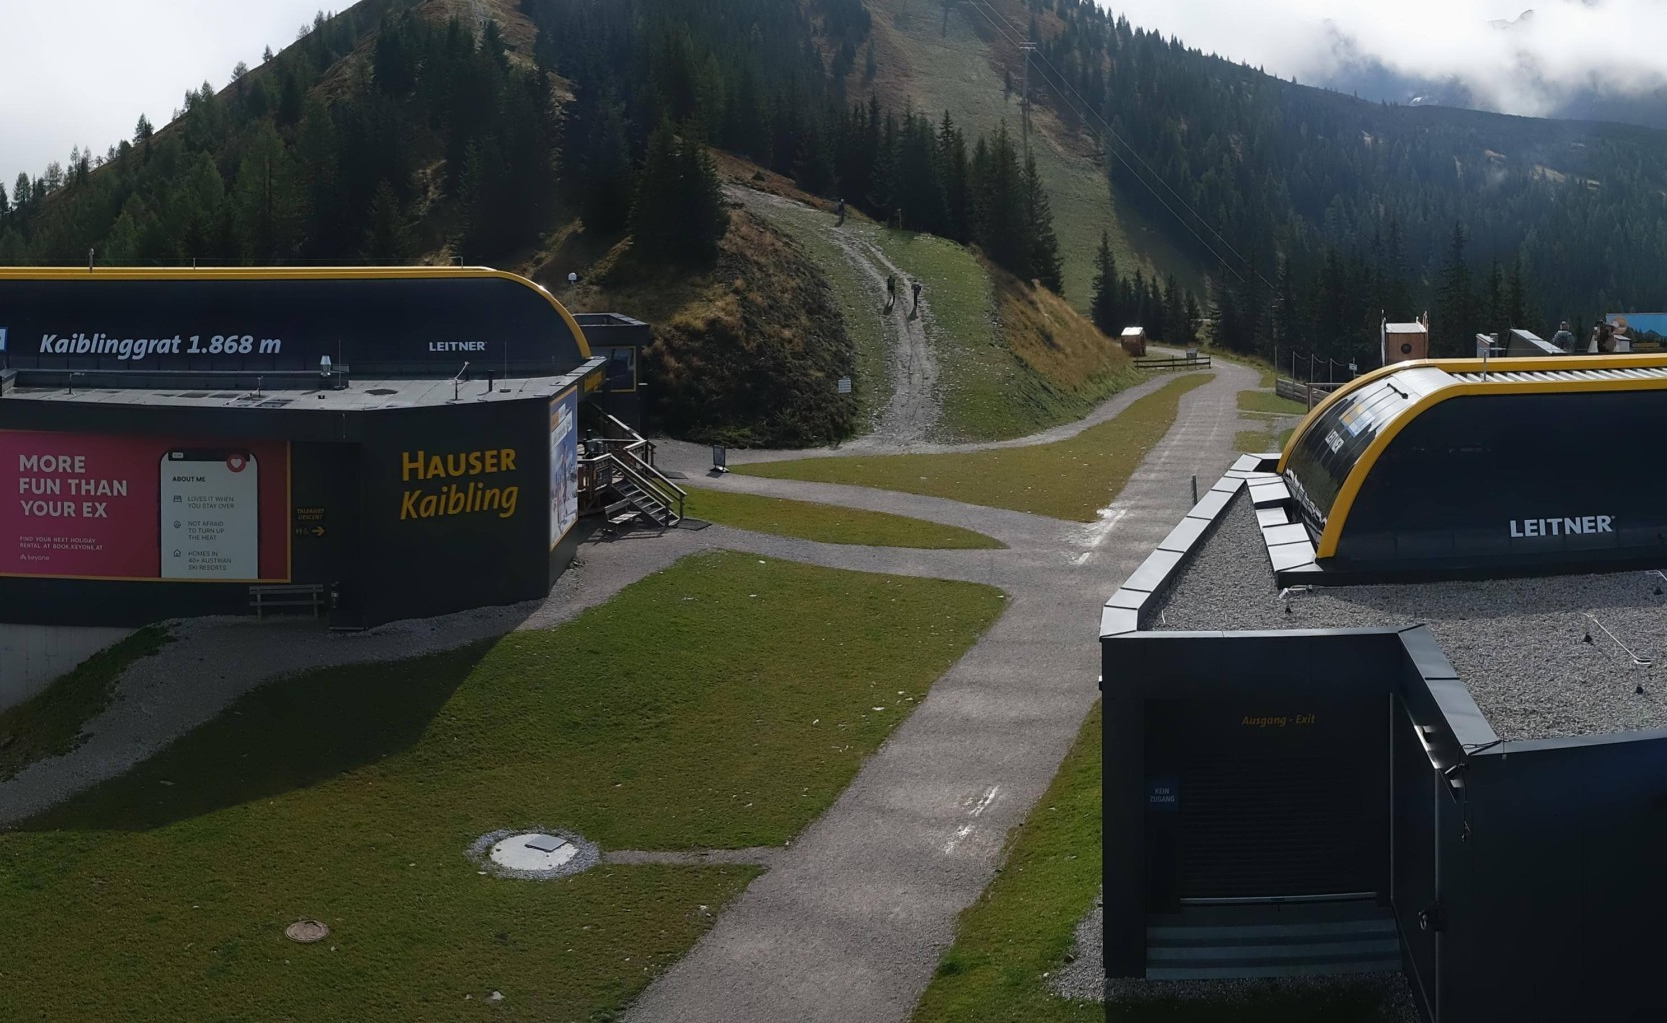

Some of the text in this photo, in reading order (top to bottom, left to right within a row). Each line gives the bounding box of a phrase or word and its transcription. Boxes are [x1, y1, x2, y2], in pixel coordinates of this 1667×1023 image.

[39, 333, 282, 360] Kaiblinggrat 1.868 m
[428, 341, 487, 352] LEITNER
[19, 454, 86, 473] MORE
[401, 449, 517, 482] HAUSER
[19, 477, 128, 496] FUN THAN
[20, 500, 108, 518] YOUR EX
[400, 482, 519, 520] Kaibling
[1509, 515, 1615, 538] LEITNER
[1241, 715, 1287, 728] Ausgang
[1295, 713, 1316, 725] Exit
